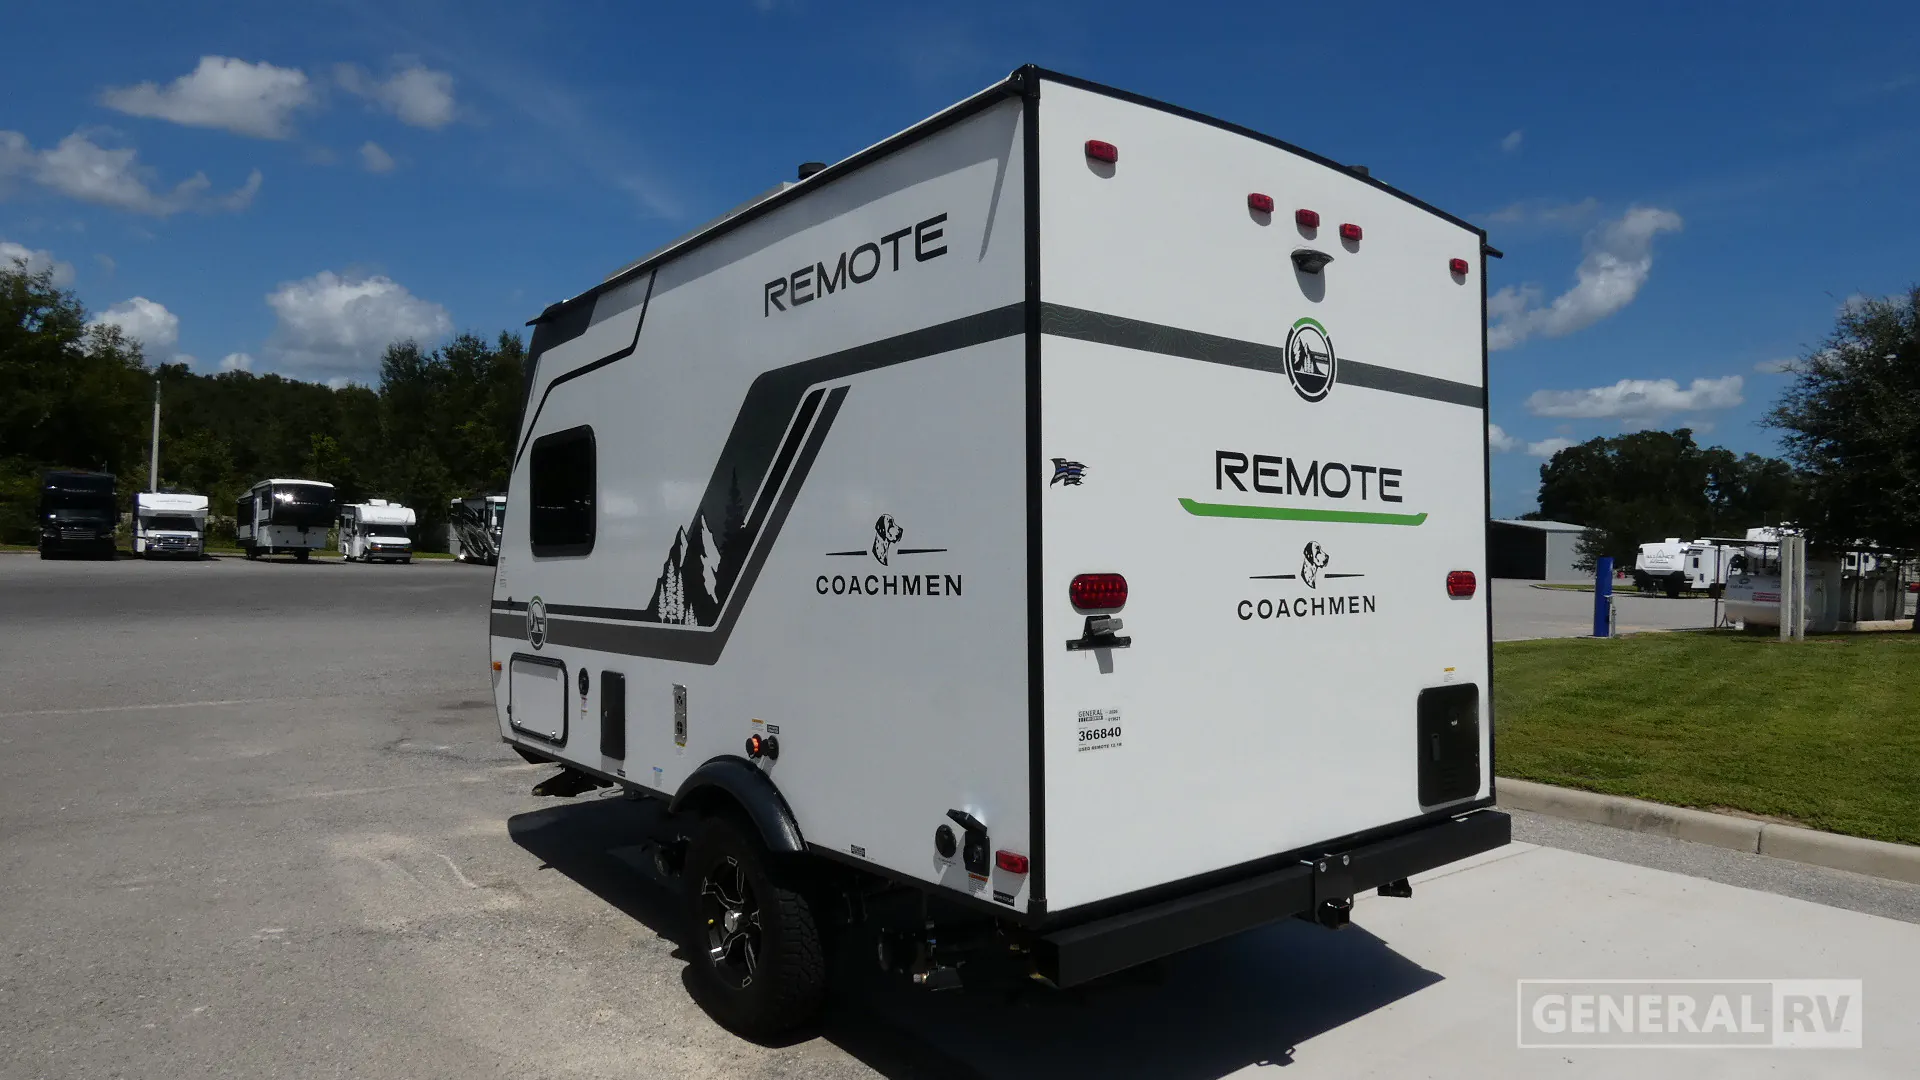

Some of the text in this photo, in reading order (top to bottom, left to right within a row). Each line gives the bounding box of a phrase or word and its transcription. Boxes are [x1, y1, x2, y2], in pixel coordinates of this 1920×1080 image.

[765, 212, 947, 318] REMOTE
[1216, 450, 1403, 503] REMOTE
[816, 574, 962, 596] COACHMEN
[1237, 595, 1376, 620] COACHMEN
[1079, 727, 1121, 741] 366840
